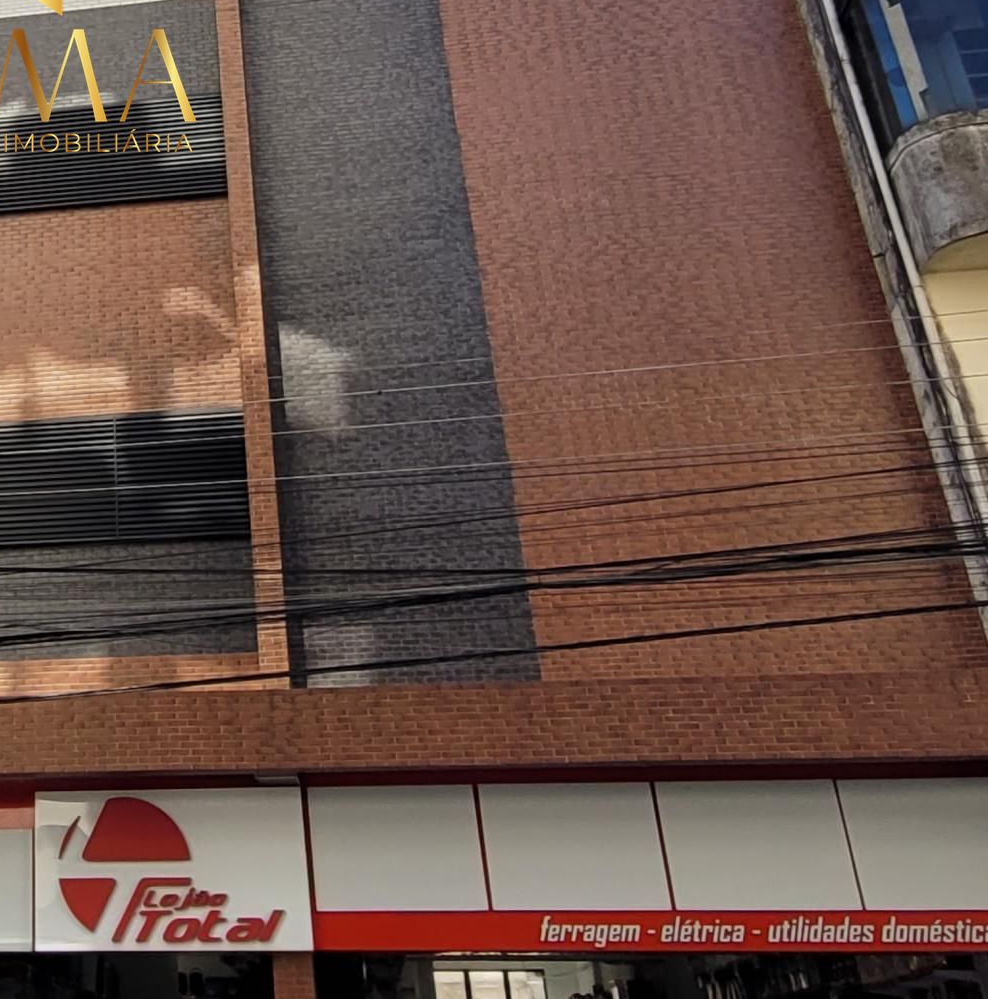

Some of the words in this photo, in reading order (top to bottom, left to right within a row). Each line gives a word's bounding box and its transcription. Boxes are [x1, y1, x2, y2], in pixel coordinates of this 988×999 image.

[136, 909, 286, 943] Total
[539, 916, 641, 948] ferragem
[660, 916, 746, 943] elétrica
[767, 916, 875, 943] utilidades
[881, 915, 988, 943] doméstic
